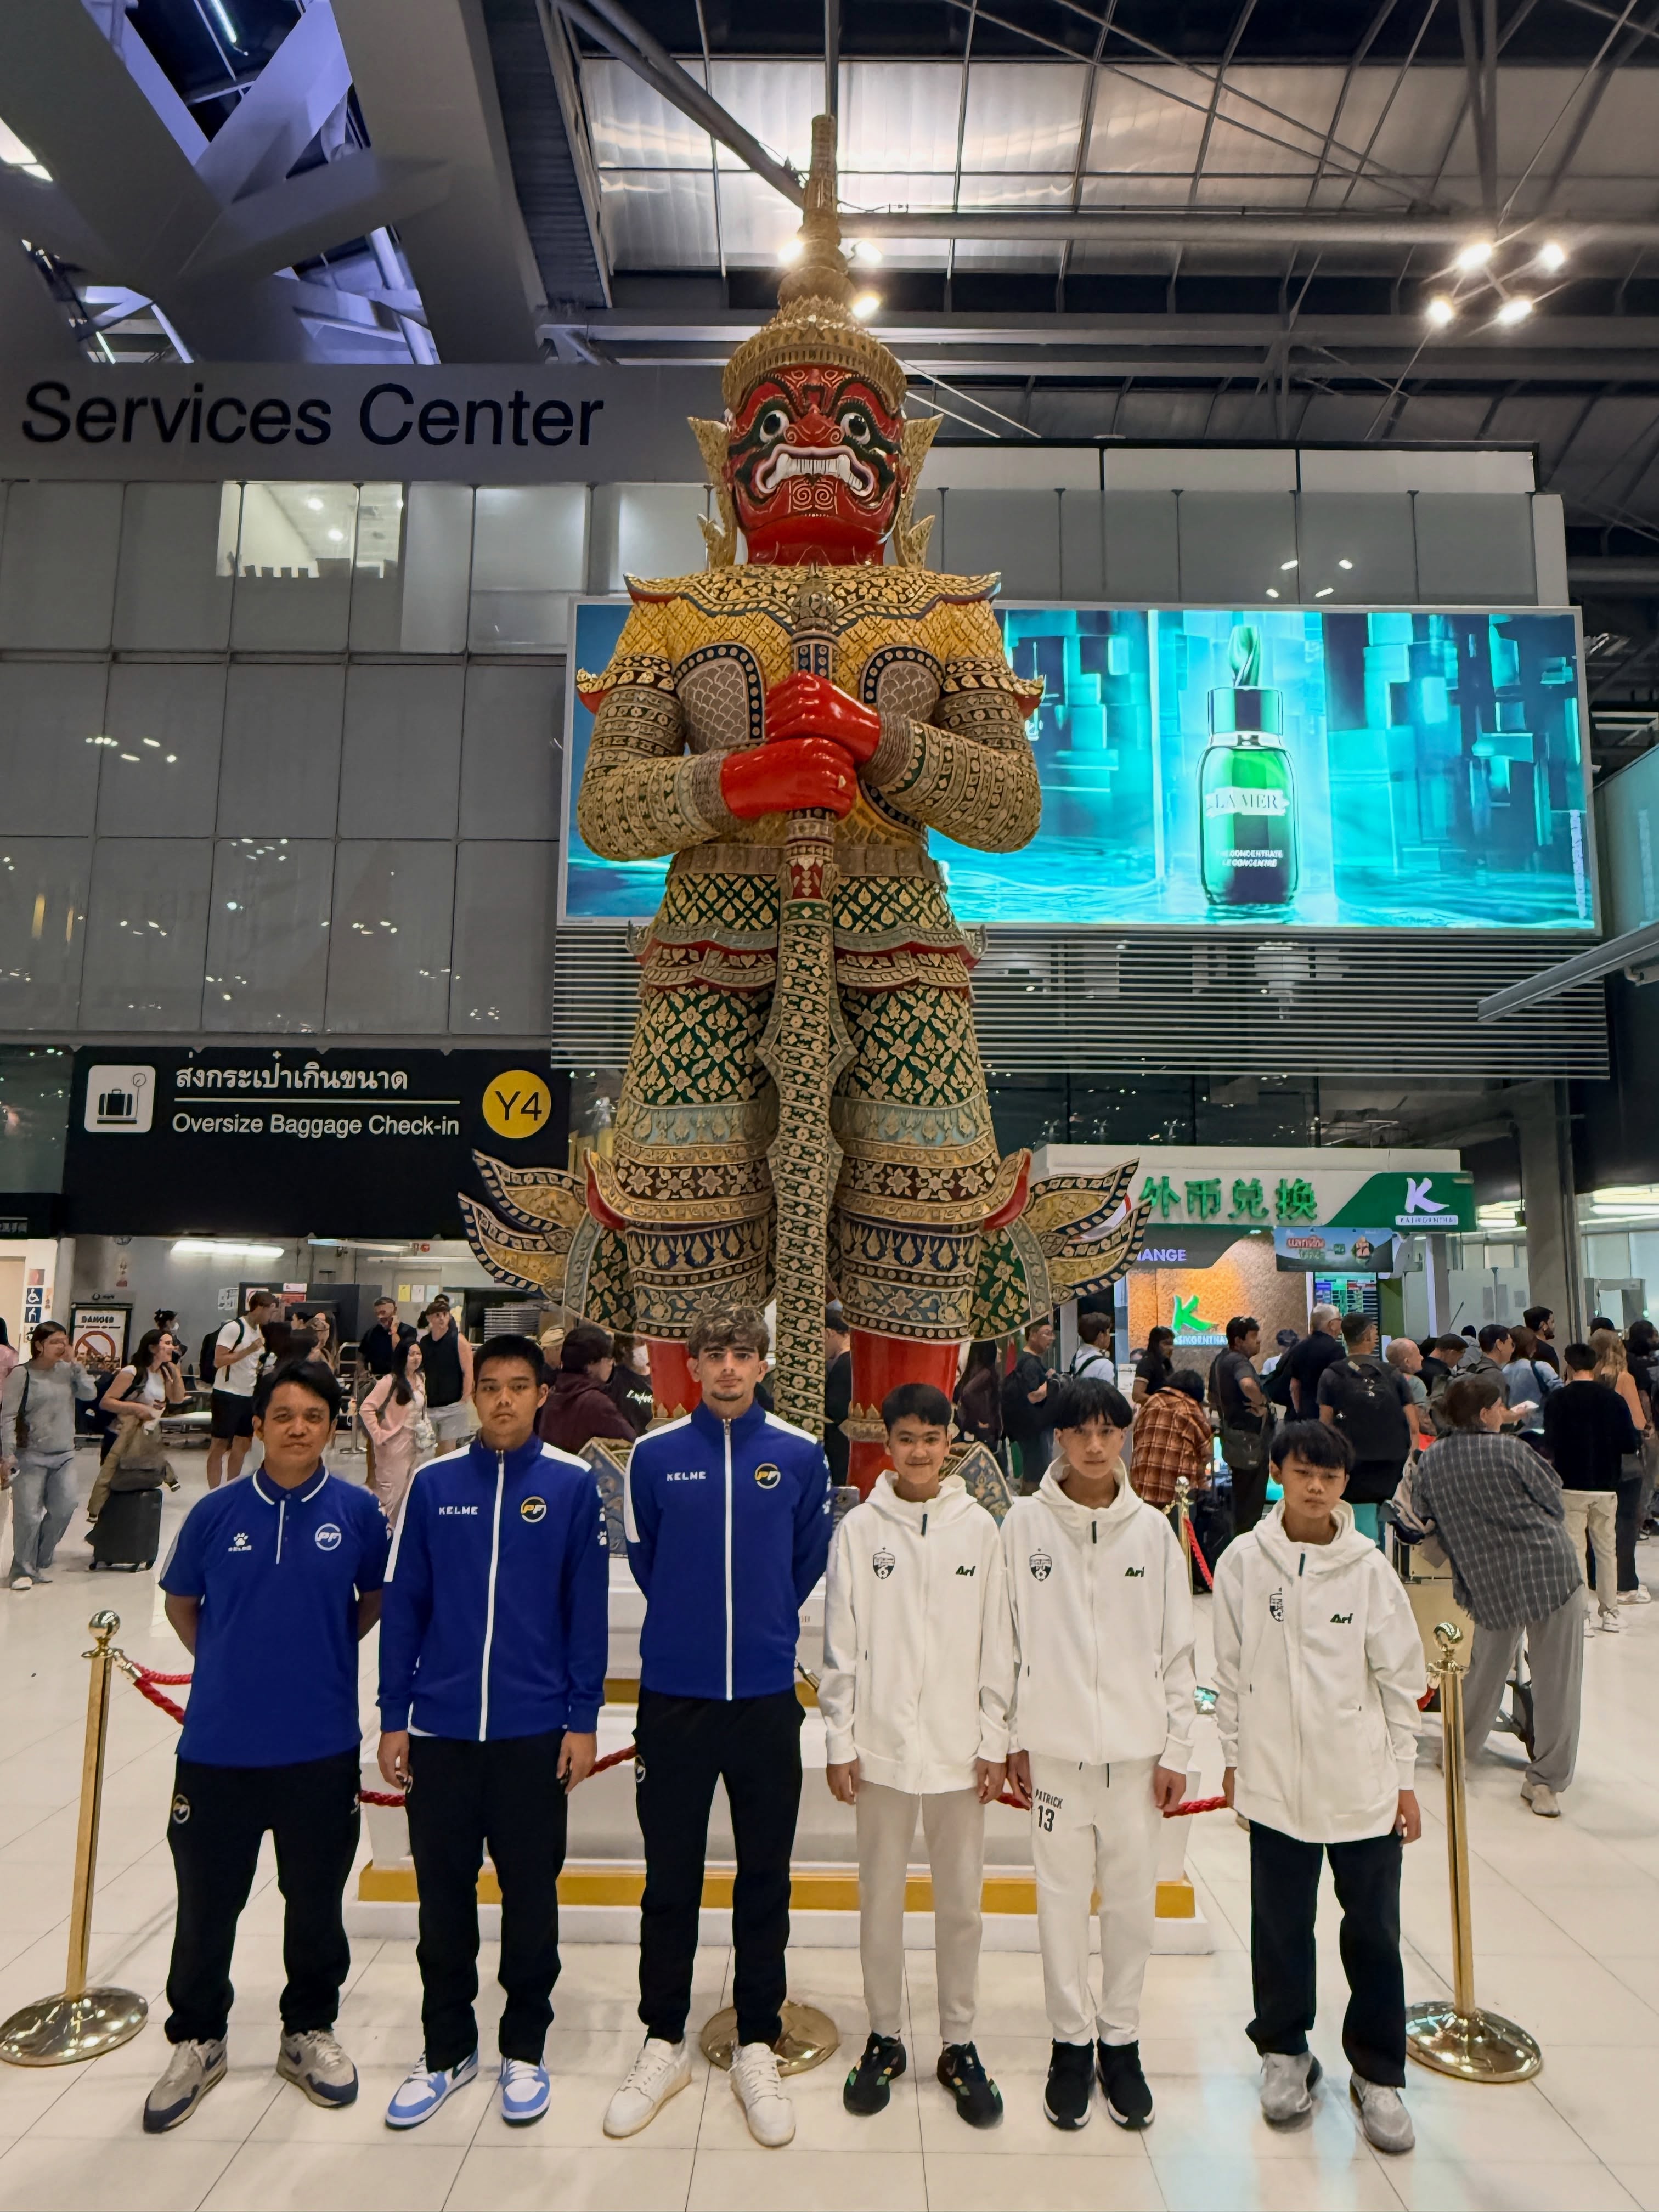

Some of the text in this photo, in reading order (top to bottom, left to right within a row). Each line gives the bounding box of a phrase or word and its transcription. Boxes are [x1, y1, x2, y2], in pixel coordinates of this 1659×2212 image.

[22, 381, 603, 446] Services Center
[1216, 794, 1278, 809] LA MER
[176, 1051, 408, 1090] ส่งกระเป๋าเกินขนาด
[495, 1091, 542, 1121] Y4
[172, 1113, 459, 1139] Oversize Baggage Check-in
[1139, 1176, 1318, 1220] 外币兑换
[1404, 1177, 1450, 1213] K
[1172, 1295, 1215, 1332] K
[667, 1471, 707, 1481] KELME
[438, 1506, 478, 1515] KELME
[1035, 1788, 1063, 1809] PATRICK
[1037, 1804, 1055, 1833] 13
